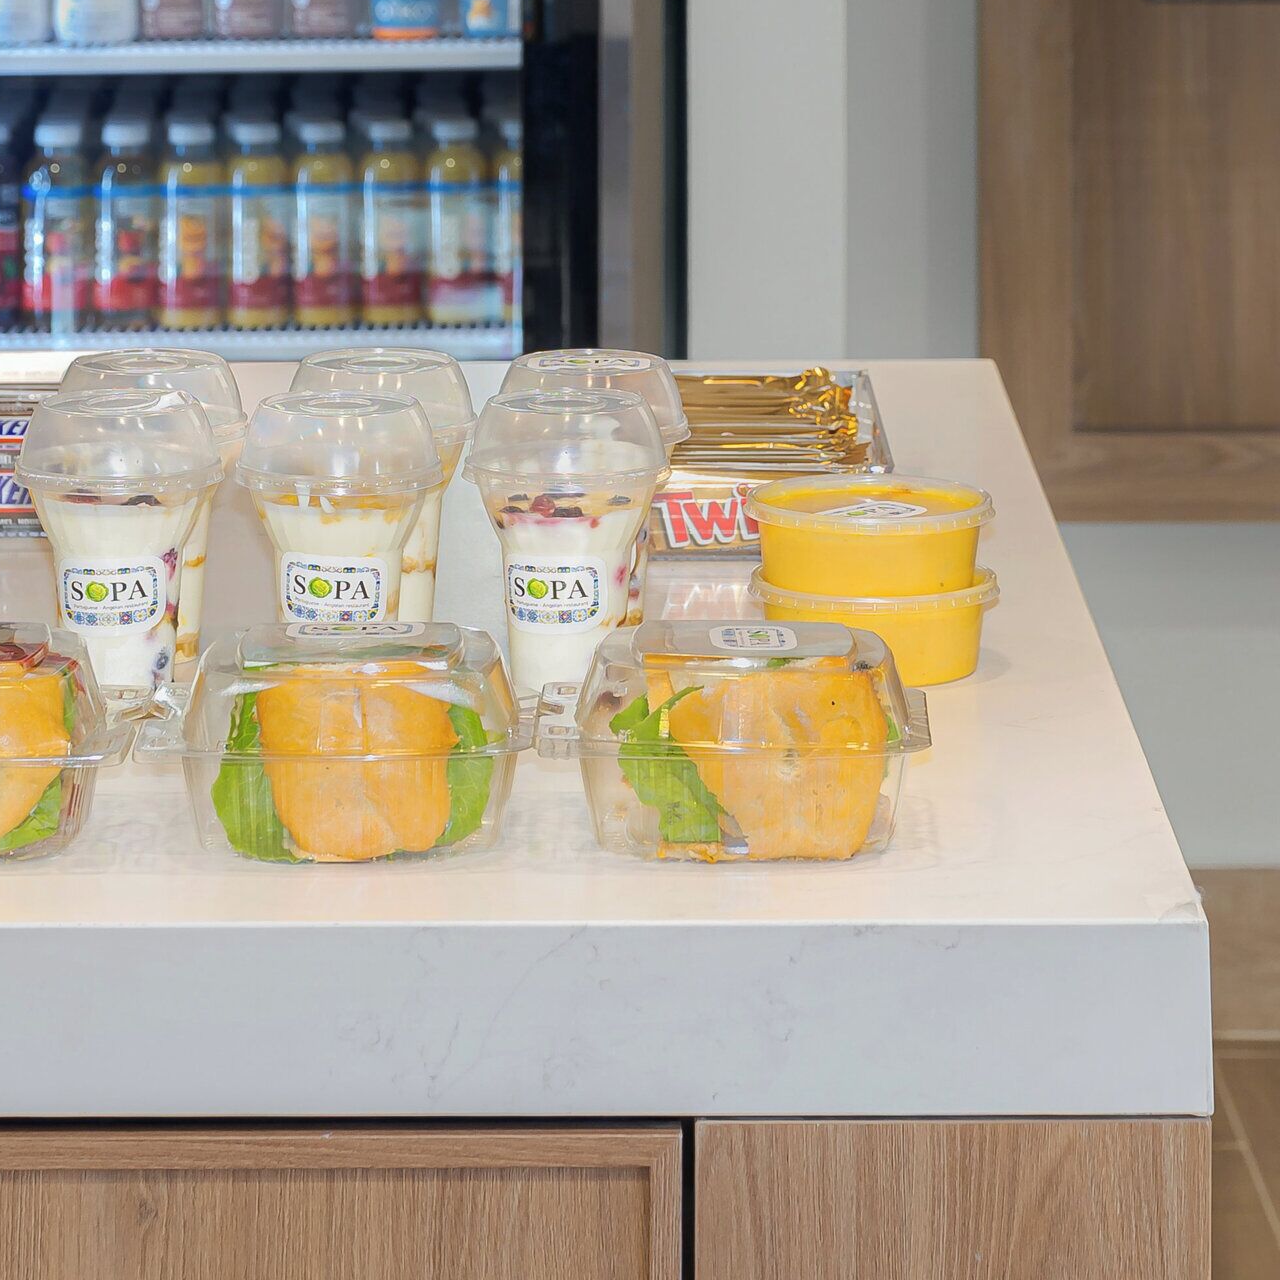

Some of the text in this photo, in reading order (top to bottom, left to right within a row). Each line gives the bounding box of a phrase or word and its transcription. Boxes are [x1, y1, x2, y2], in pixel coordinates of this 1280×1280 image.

[652, 483, 760, 545] Twi
[70, 579, 149, 601] SOPA
[293, 574, 370, 600] SOPA
[513, 577, 589, 600] SOPA
